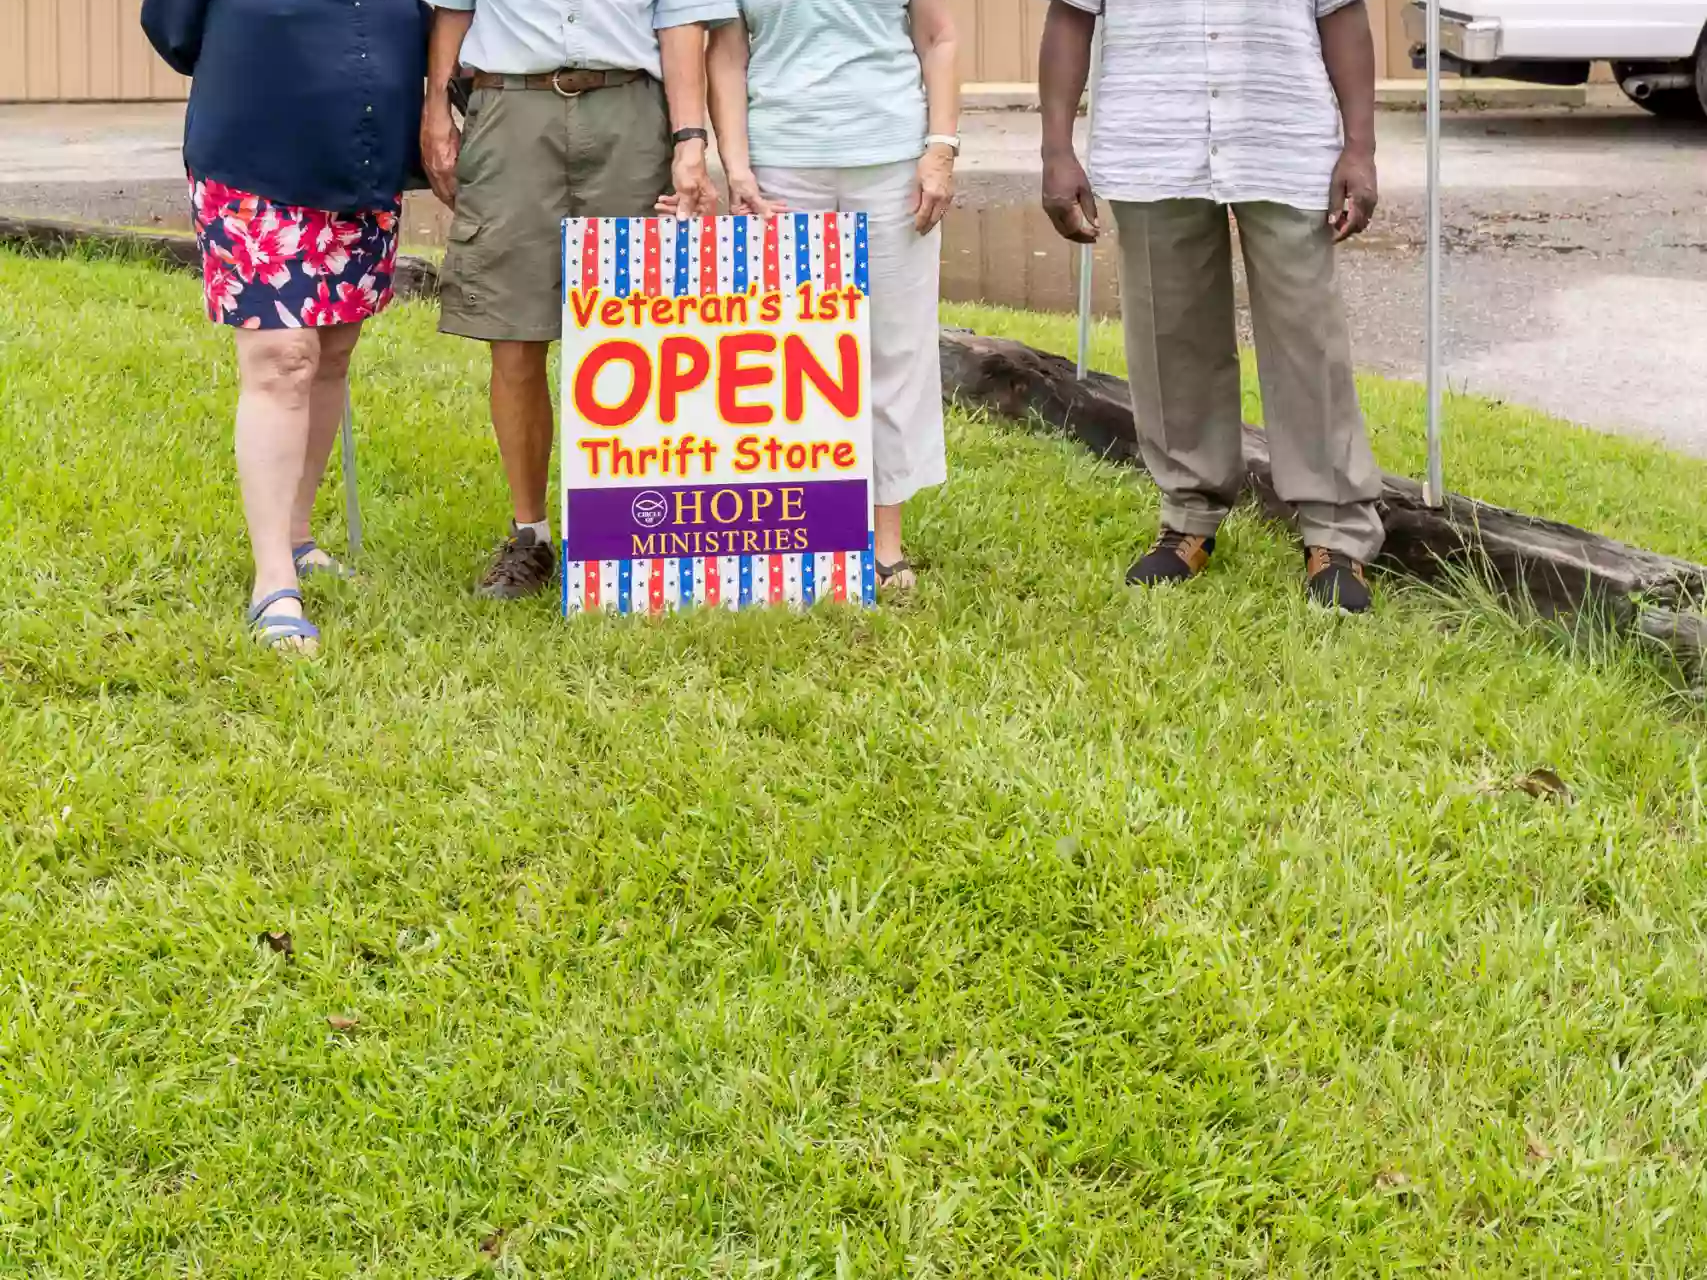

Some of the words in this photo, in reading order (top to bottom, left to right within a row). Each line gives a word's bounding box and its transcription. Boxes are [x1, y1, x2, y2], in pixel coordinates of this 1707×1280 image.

[569, 282, 782, 328] Veteran's
[796, 279, 863, 322] 1st
[573, 331, 861, 427] OPEN
[579, 433, 718, 477] Thrift
[734, 435, 857, 473] Store
[672, 487, 807, 526] HOPE
[631, 528, 810, 556] MINISTRIES
